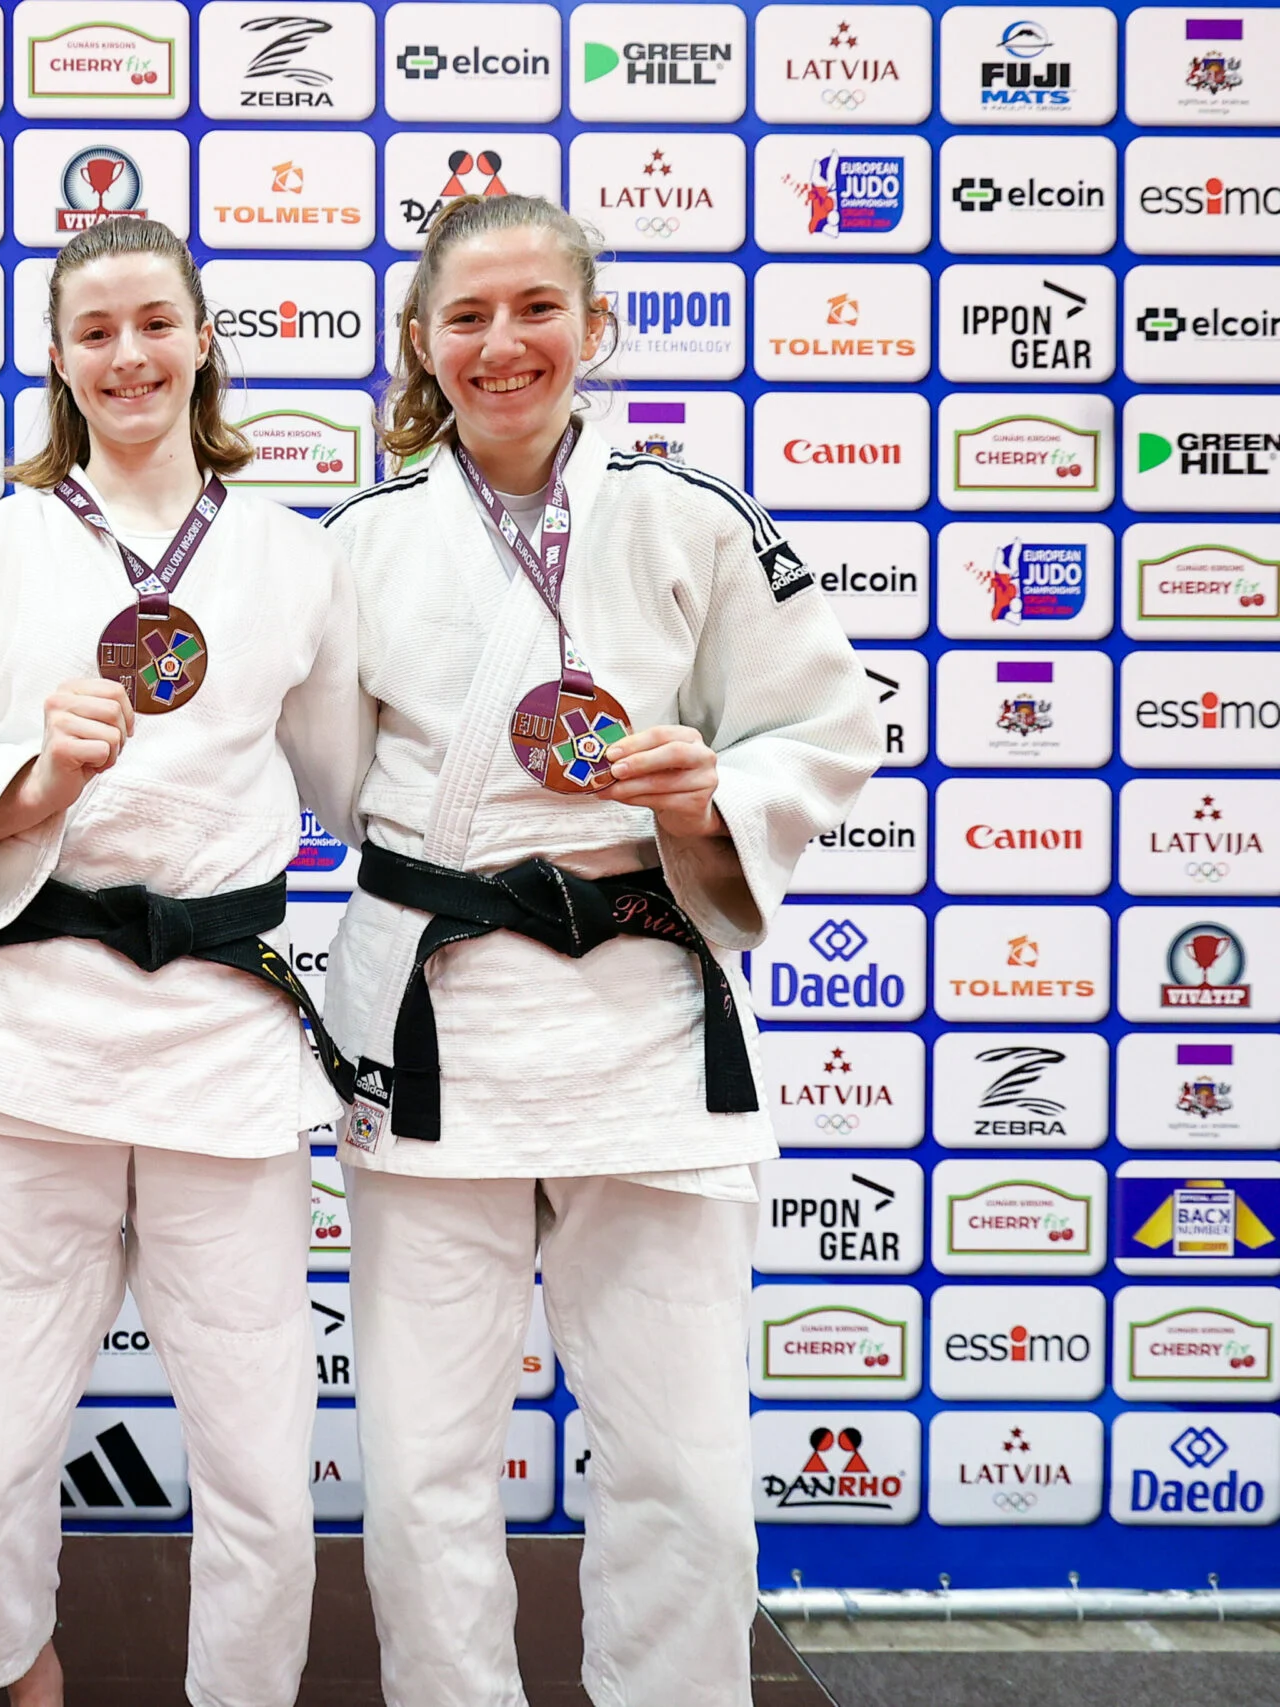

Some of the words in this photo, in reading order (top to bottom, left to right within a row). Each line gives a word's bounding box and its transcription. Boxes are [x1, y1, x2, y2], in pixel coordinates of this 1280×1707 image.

[453, 46, 549, 75] elcoin
[623, 43, 731, 61] GREEN
[50, 58, 123, 72] CHERRY
[627, 62, 716, 84] HILL
[787, 60, 899, 82] LATVIJA
[982, 63, 1070, 88] FUJI
[241, 91, 333, 107] ZEBRA
[982, 90, 1070, 104] MATS
[840, 162, 898, 176] EUROPEAN
[601, 187, 713, 210] LATVIJA
[840, 175, 900, 199] JUDO
[1008, 178, 1104, 206] elcoin
[214, 206, 361, 224] TOLMETS
[213, 301, 361, 338] essimo
[628, 291, 730, 334] ippon
[963, 305, 1051, 335] IPPON
[648, 340, 730, 354] TECHNOLOGY
[769, 339, 916, 356] TOLMETS
[1012, 339, 1091, 369] GEAR
[783, 439, 901, 464] Canon
[1177, 433, 1280, 451] GREEN
[975, 451, 1048, 464] CHERRY
[1182, 452, 1269, 474] HILL
[466, 460, 480, 486] TOUR
[480, 484, 494, 508] 2024
[515, 538, 545, 587] EUROPEAN
[1023, 549, 1081, 563] EUROPEAN
[771, 563, 810, 591] adidas
[821, 563, 917, 592] elcoin
[1023, 562, 1082, 585] JUDO
[1159, 581, 1232, 594] CHERRY
[100, 642, 135, 668] EJU
[1136, 692, 1280, 729] essimo
[512, 711, 553, 740] EJU
[819, 821, 914, 847] elcoin
[965, 825, 1082, 849] Canon
[1151, 832, 1262, 855] LATVIJA
[771, 962, 905, 1008] Daedo
[950, 980, 1095, 997] TOLMETS
[356, 1078, 388, 1100] adidas
[781, 1085, 892, 1107] LATVIJA
[974, 1121, 1066, 1135] ZEBRA
[772, 1199, 859, 1228] IPPON
[968, 1216, 1041, 1229] CHERRY
[820, 1232, 899, 1261] GEAR
[784, 1341, 856, 1354] CHERRY
[945, 1325, 1090, 1362] essimo
[1150, 1343, 1223, 1356] CHERRY
[960, 1464, 1071, 1486] LATVIJA
[763, 1474, 901, 1502] DANRHO
[1131, 1469, 1264, 1513] Daedo
